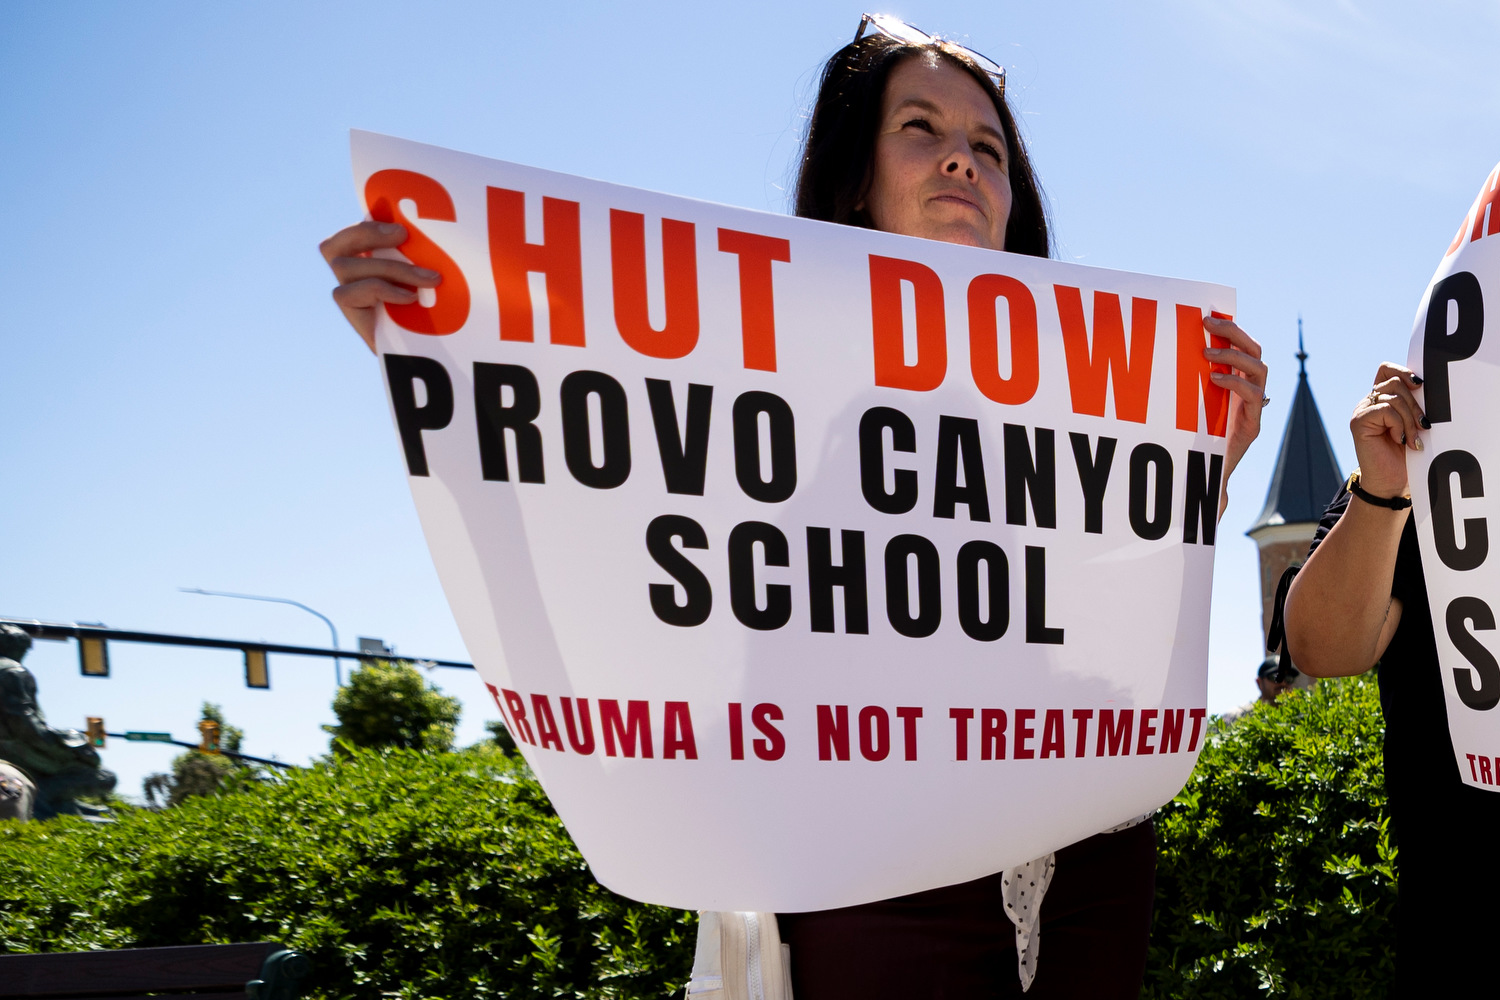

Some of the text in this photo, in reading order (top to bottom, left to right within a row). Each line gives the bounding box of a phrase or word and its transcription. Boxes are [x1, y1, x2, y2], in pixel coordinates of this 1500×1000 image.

[364, 168, 1234, 438] SHUT DOWN
[383, 353, 1224, 546] PROVO CANYON
[645, 514, 1064, 645] SCHOOL
[485, 682, 1206, 761] TRAUMA IS NOT TREATMENT
